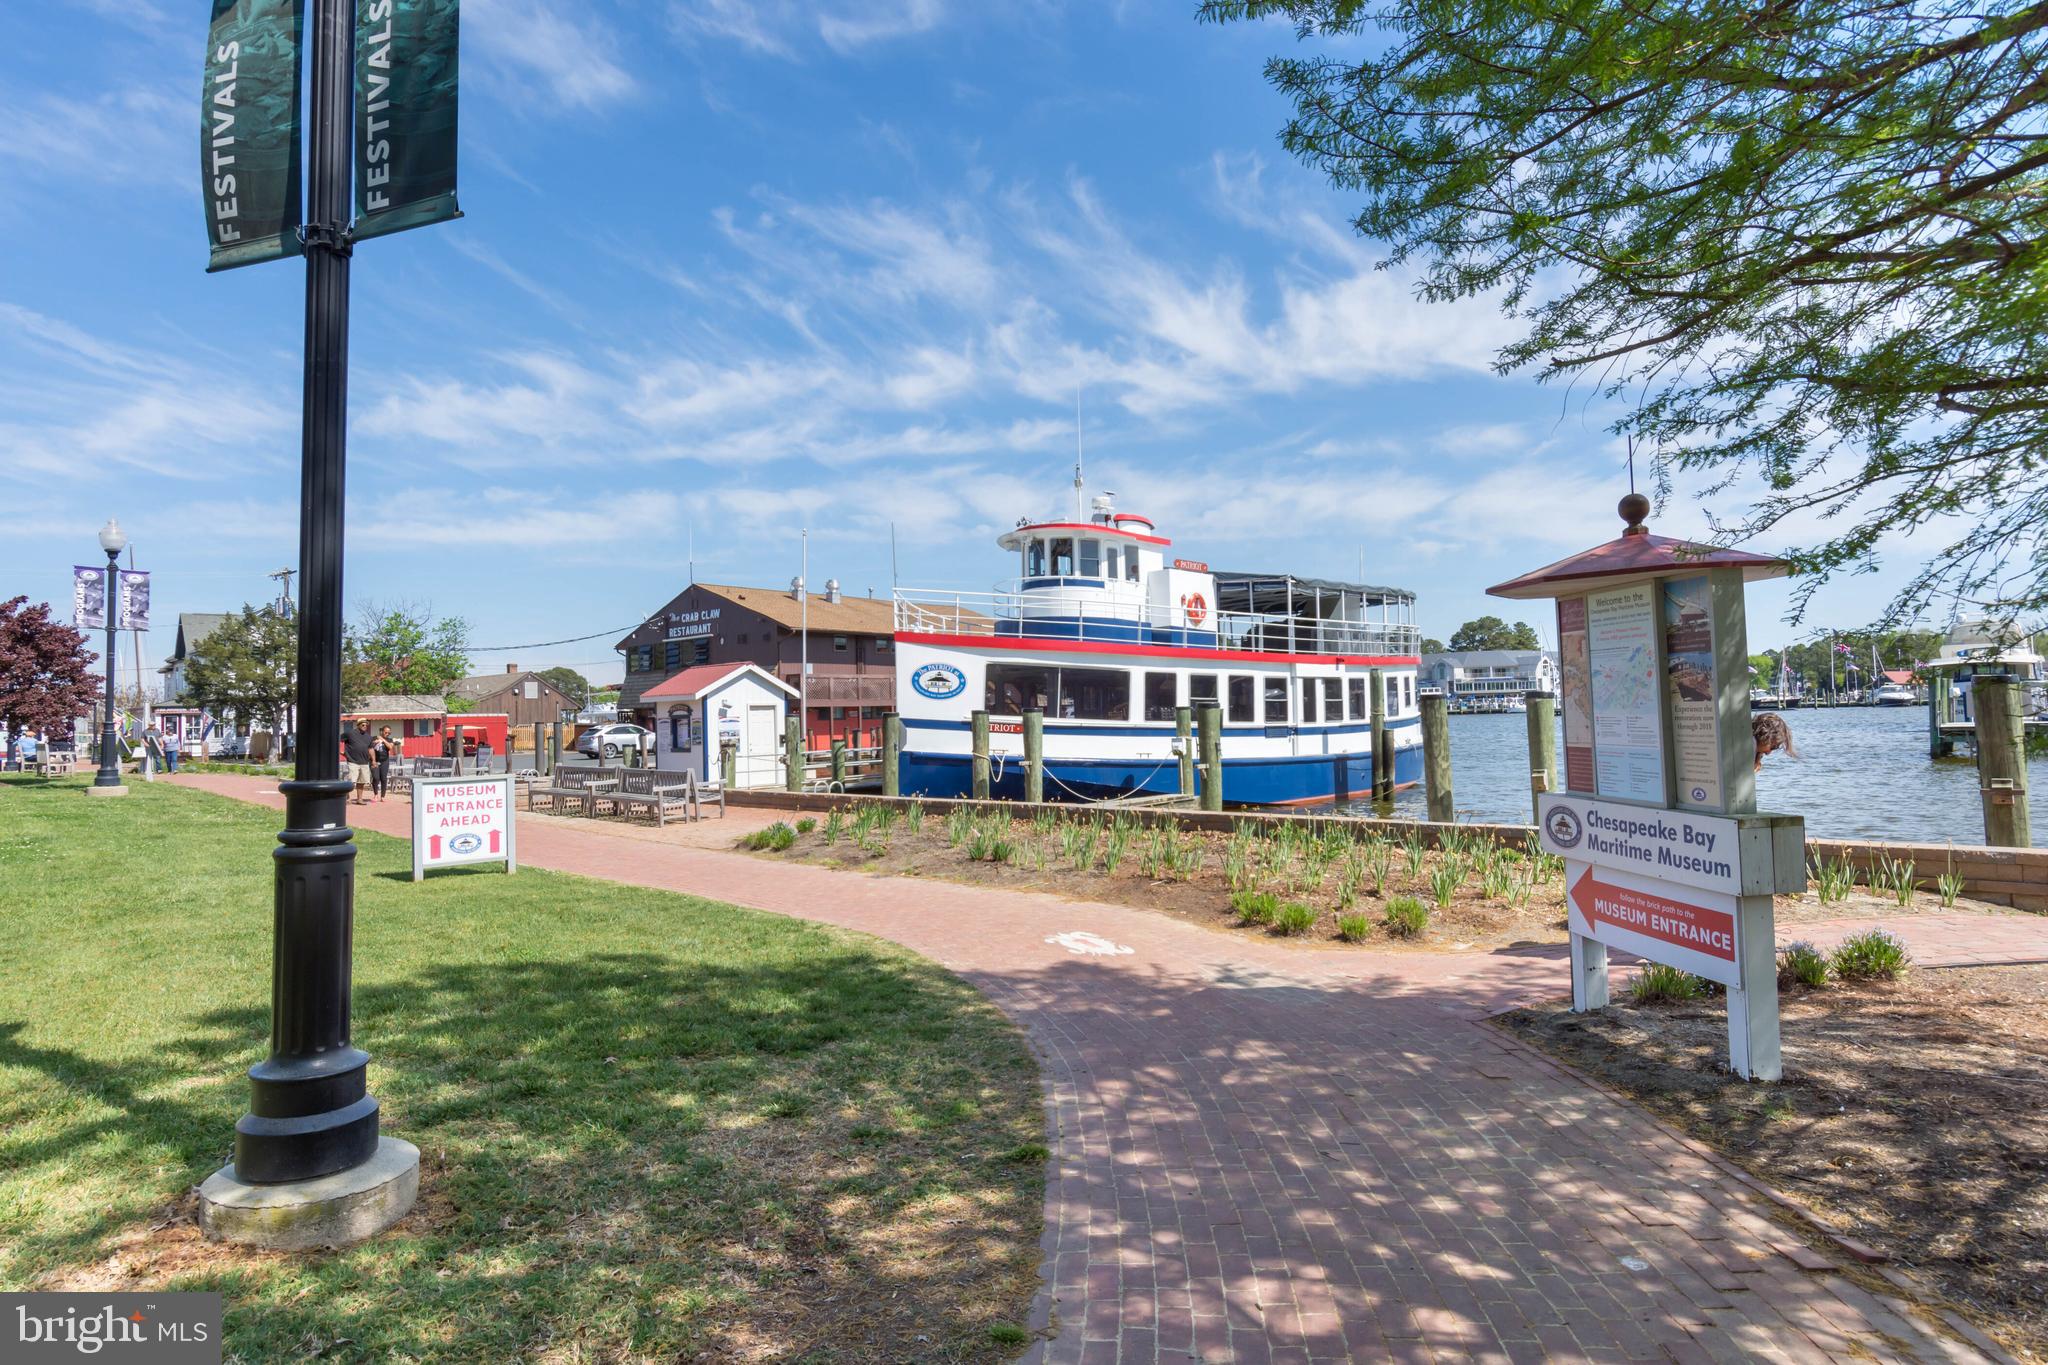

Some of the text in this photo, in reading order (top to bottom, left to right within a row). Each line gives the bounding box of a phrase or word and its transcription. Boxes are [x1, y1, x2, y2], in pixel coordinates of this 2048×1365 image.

[367, 0, 392, 211] FESTIVALS
[213, 40, 241, 243] FESTIVALS
[1180, 560, 1202, 571] PATRIOT
[76, 583, 86, 624] PROGRAMS
[123, 586, 132, 627] PROGRAMS
[1596, 597, 1623, 607] Welcome
[1624, 594, 1631, 603] to
[1632, 592, 1643, 601] the
[669, 609, 720, 622] The CRAB CLAW
[669, 623, 711, 637] RESTAURANT
[928, 664, 954, 673] PATRIOT
[989, 723, 1016, 733] TRIOT
[434, 784, 496, 798] MUSEUM
[426, 799, 503, 813] ENTRANCE
[440, 814, 491, 828] AHEAD
[1586, 810, 1677, 841] Chesapeake
[1683, 824, 1716, 853] Bay
[1587, 833, 1731, 878] Maritime Museum
[1620, 893, 1695, 919] follow the brick path to the
[1594, 897, 1731, 951] MUSEUM ENTRANCE
